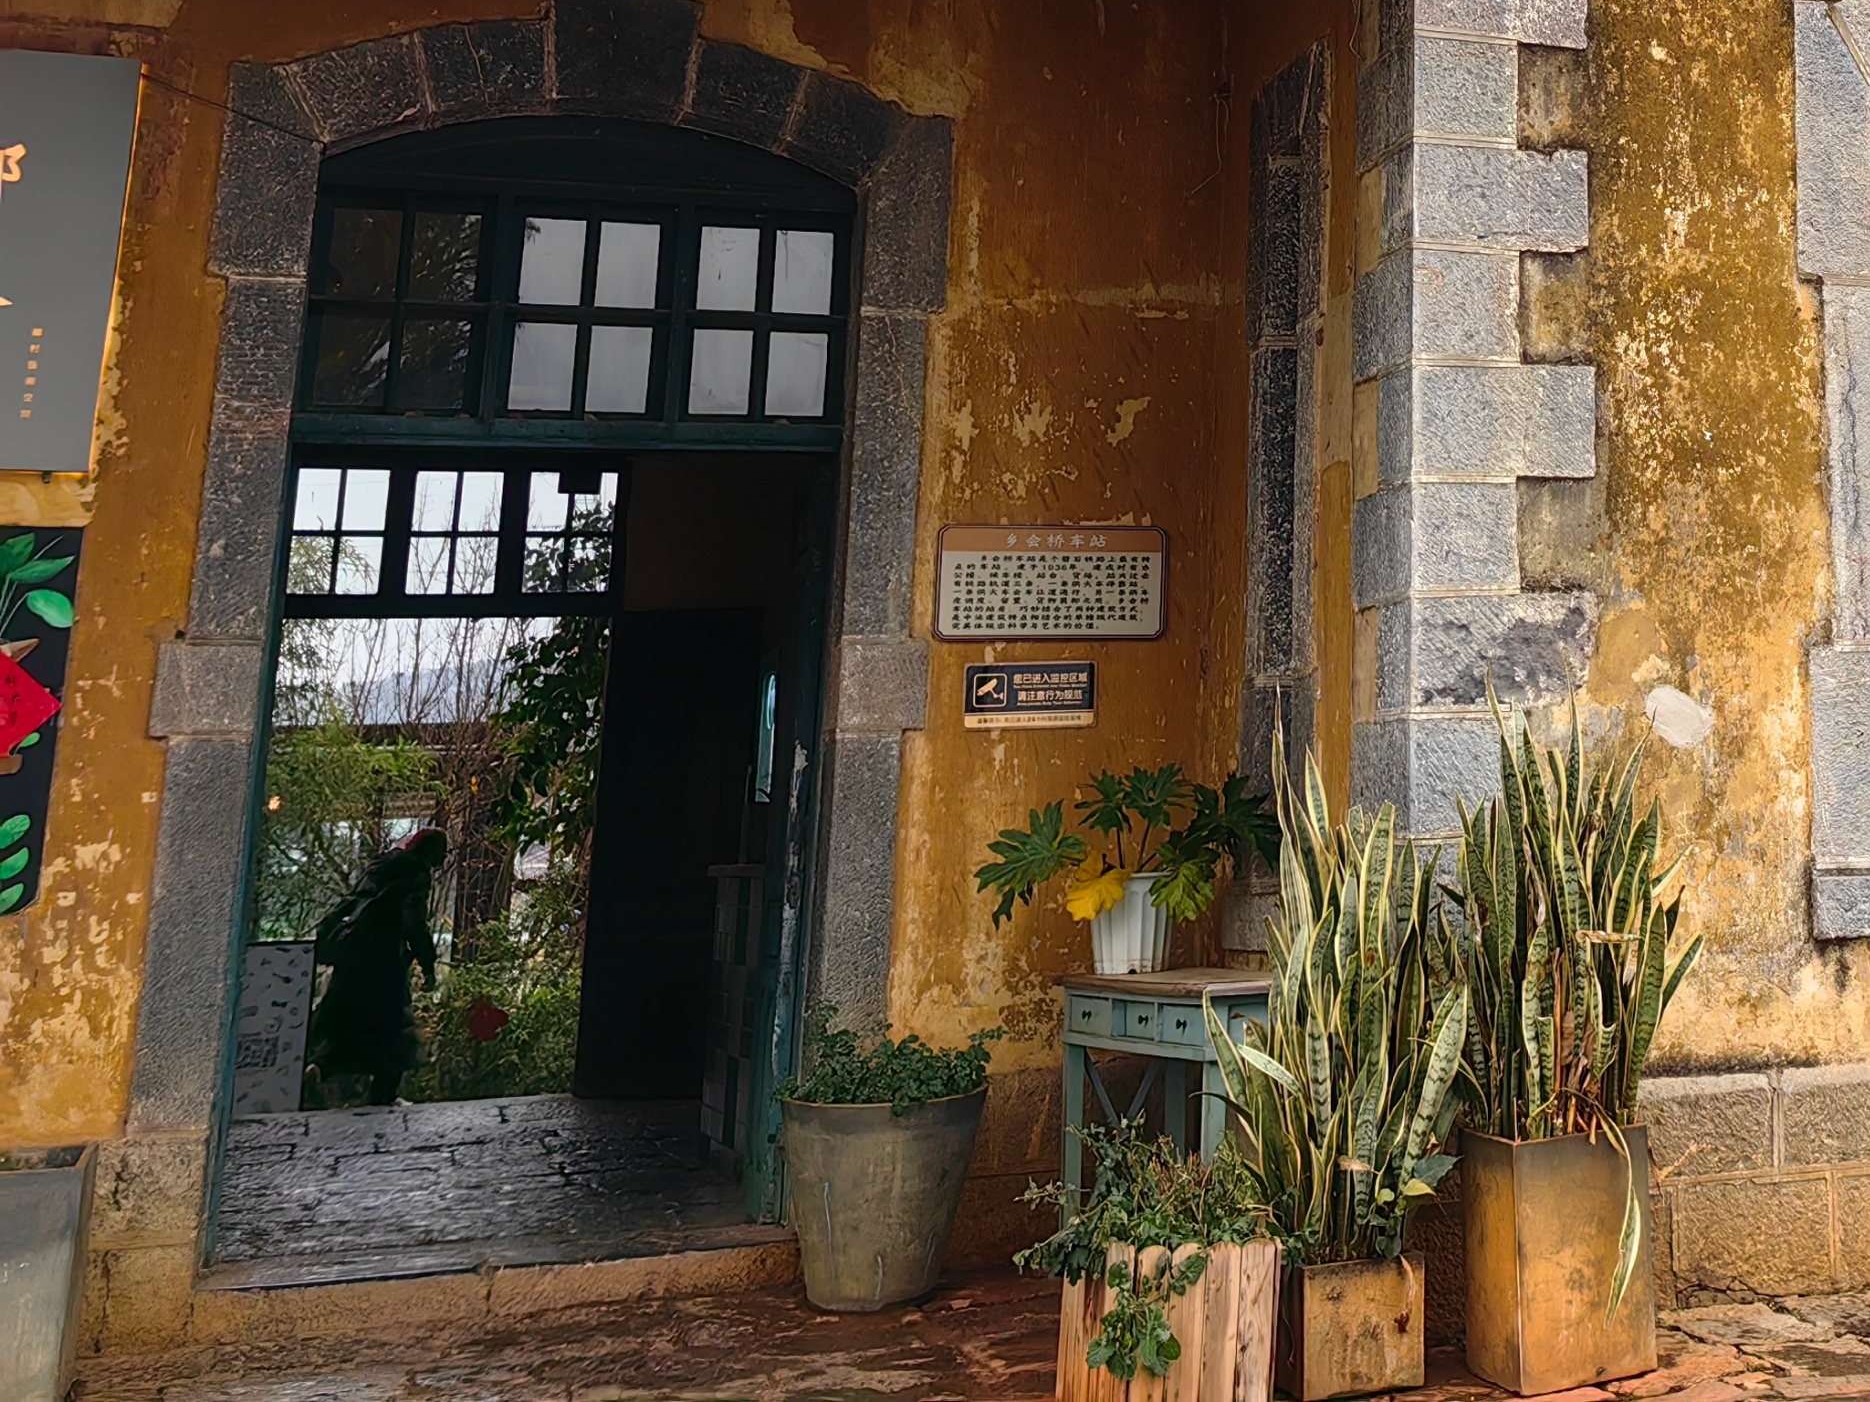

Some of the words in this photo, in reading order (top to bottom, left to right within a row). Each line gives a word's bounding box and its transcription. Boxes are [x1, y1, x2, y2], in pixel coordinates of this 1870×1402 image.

[1005, 532, 1108, 549] 乡会桥车站
[1013, 672, 1088, 684] 您已进入监控区域
[1017, 689, 1083, 701] 请注意行为规范
